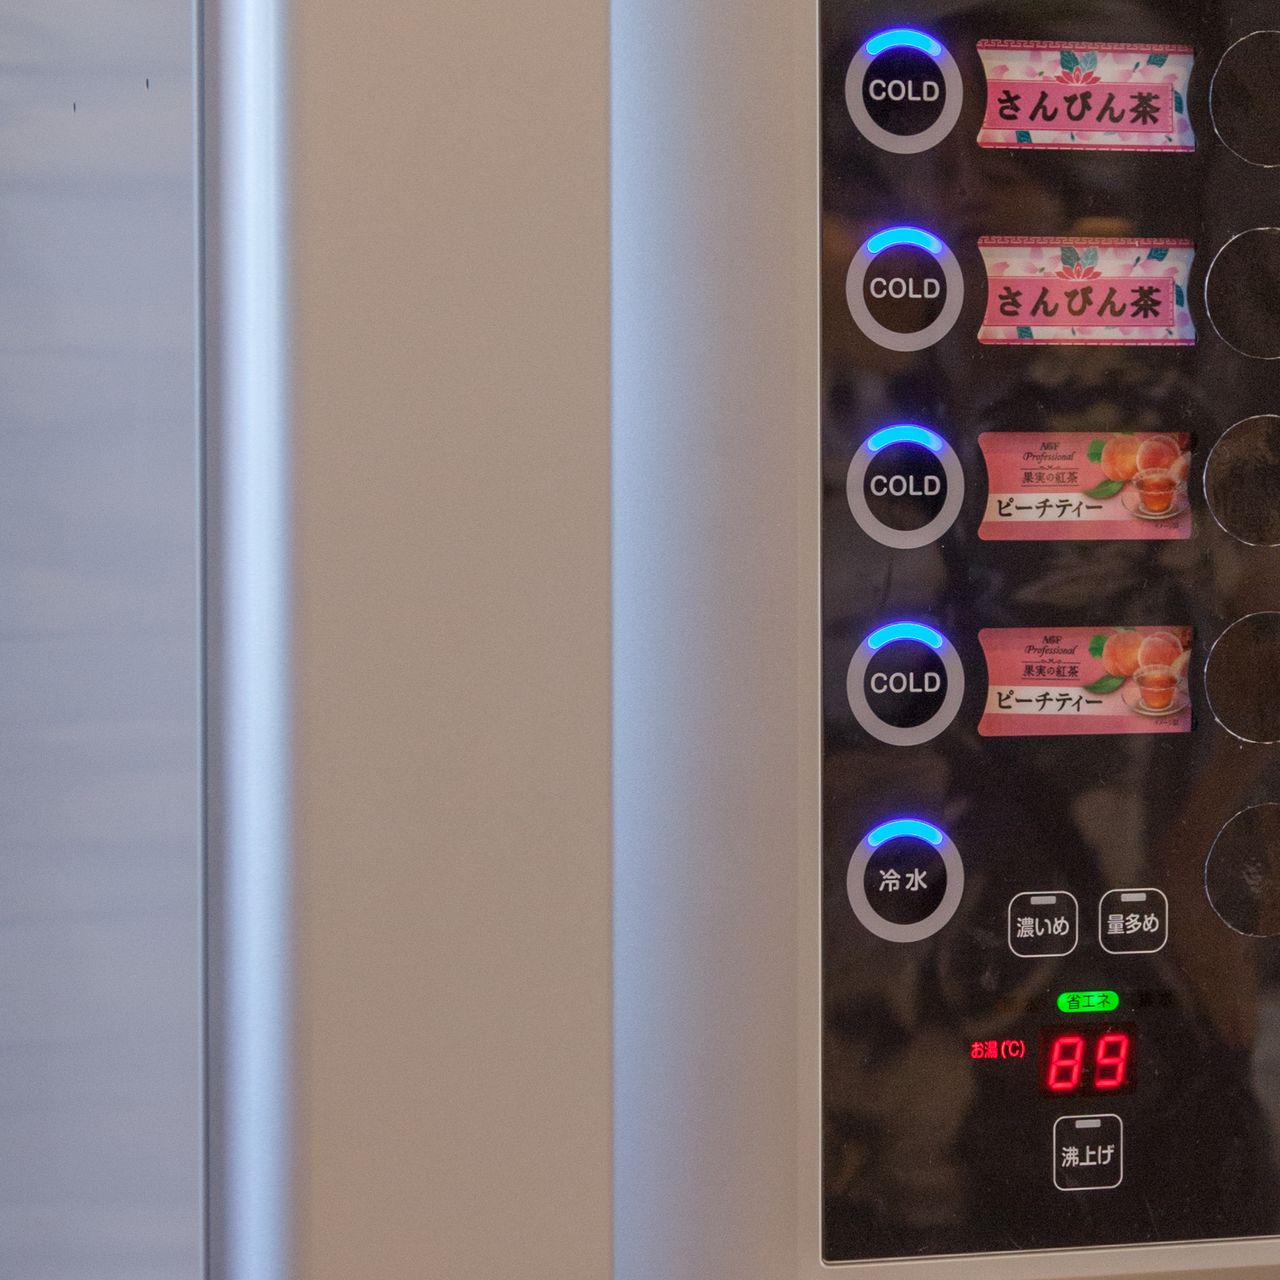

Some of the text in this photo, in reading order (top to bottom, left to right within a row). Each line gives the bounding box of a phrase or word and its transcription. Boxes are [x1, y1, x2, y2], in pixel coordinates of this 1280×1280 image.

[868, 79, 940, 102] COLD
[869, 277, 941, 300] COLD
[1023, 451, 1076, 464] Professional
[870, 474, 941, 497] COLD
[1023, 471, 1079, 484] 果実の紅茶
[996, 497, 1104, 519] ピーチティー
[1024, 645, 1078, 657] Professional
[1023, 664, 1079, 677] 果実の紅茶
[870, 671, 941, 694] COLD
[996, 689, 1103, 713] ピーチティー
[878, 868, 928, 893] 冷水
[1016, 916, 1070, 939] 濃いめ
[1106, 913, 1160, 936] 量多め
[1067, 993, 1112, 1010] 省エネ
[1047, 1033, 1130, 1091] 89
[1061, 1145, 1115, 1169] 沸上げ
